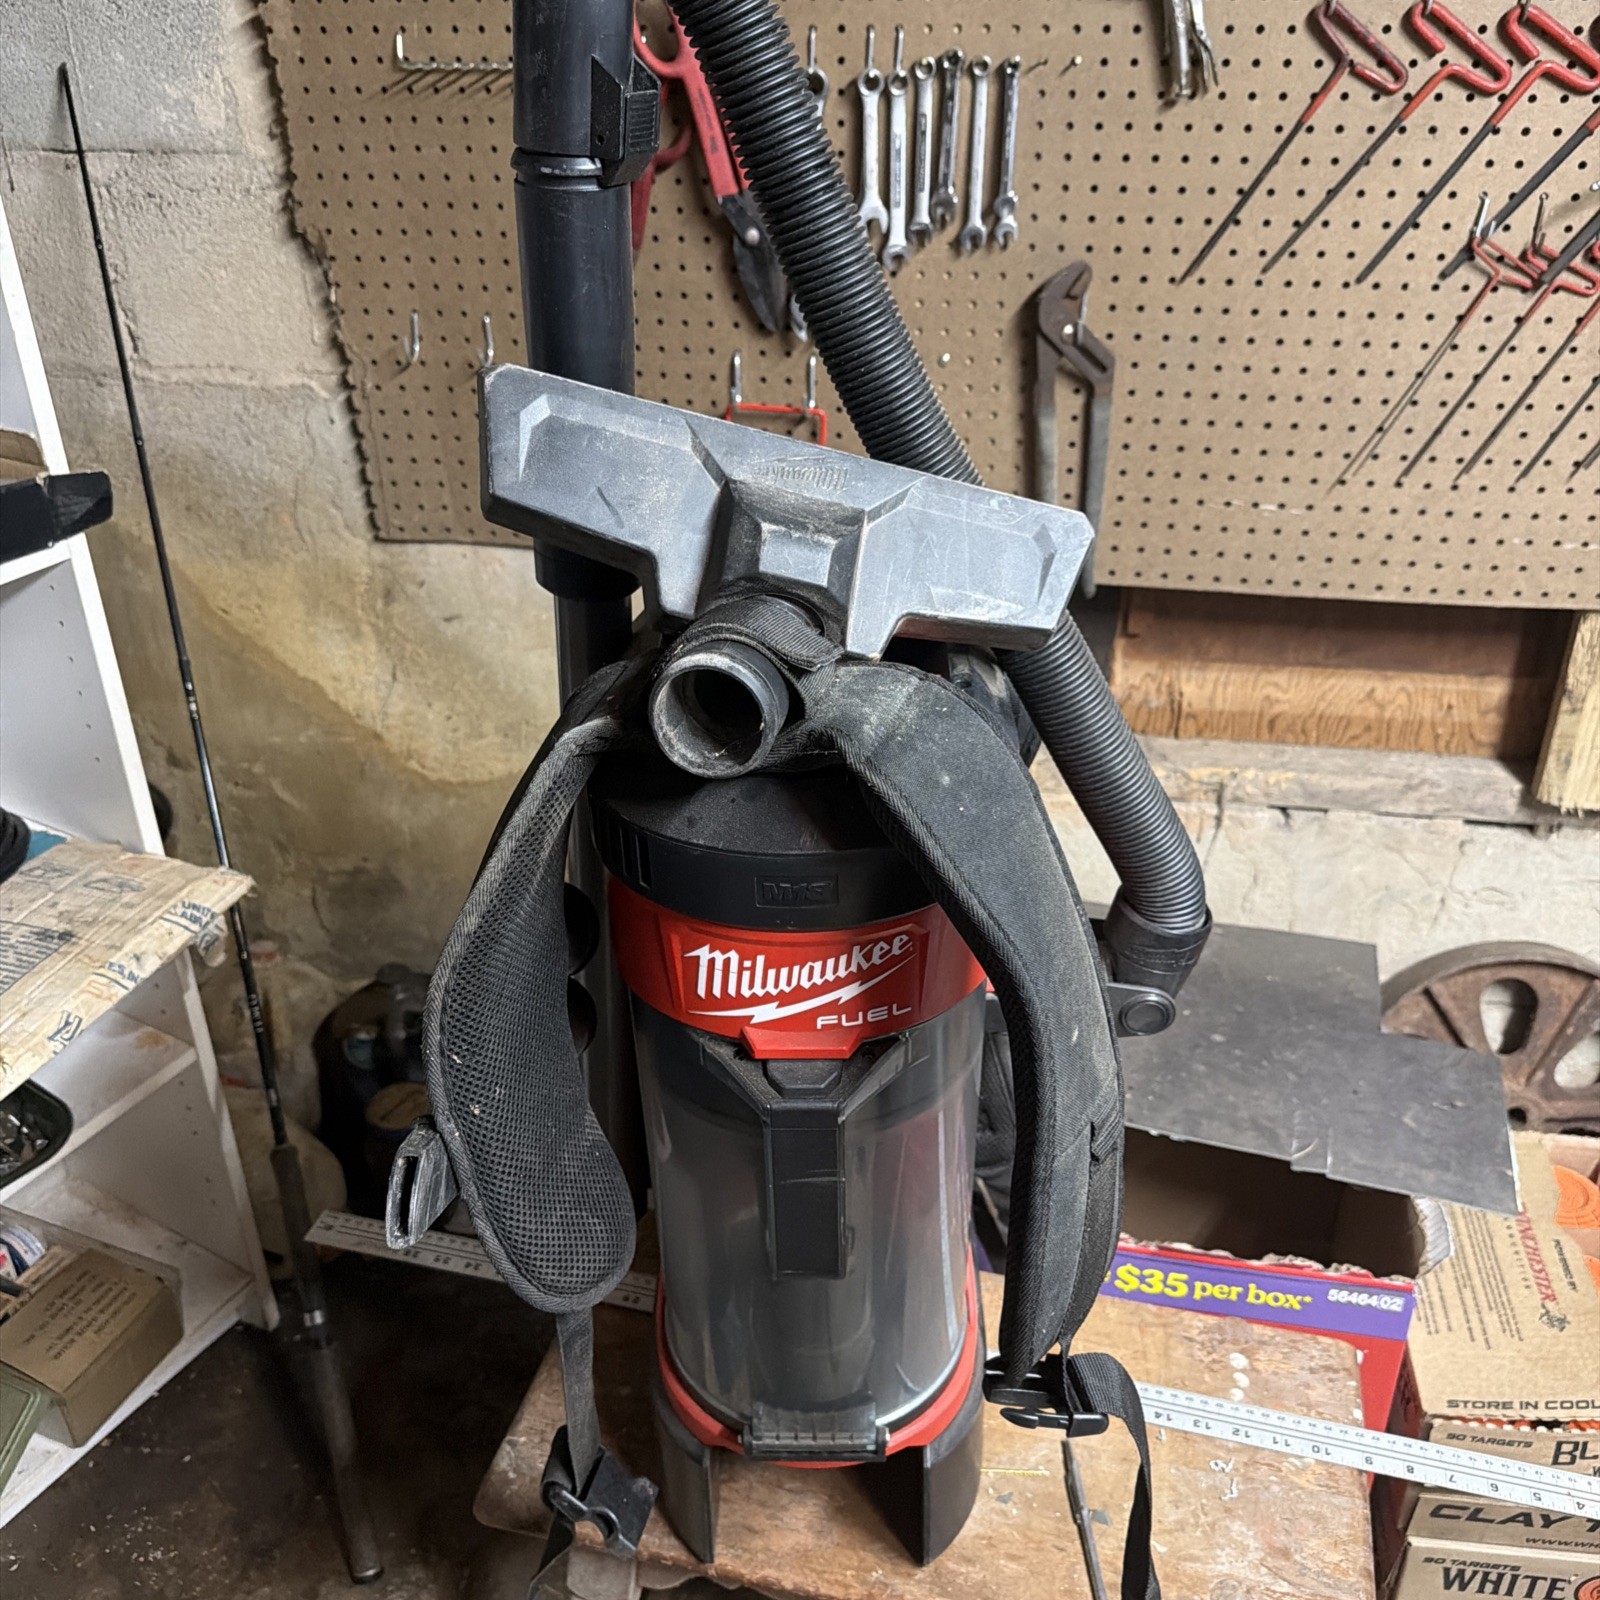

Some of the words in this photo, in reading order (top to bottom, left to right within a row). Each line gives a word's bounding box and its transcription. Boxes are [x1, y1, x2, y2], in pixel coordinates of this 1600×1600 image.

[684, 933, 914, 1000] Milwaukee
[816, 1003, 912, 1029] FUEL
[1114, 1263, 1189, 1298] $35
[1193, 1279, 1243, 1301] per
[1447, 1399, 1514, 1410] STORE
[1519, 1400, 1539, 1410] IN
[1545, 1399, 1600, 1410] COOL
[1154, 1411, 1172, 1423] 14
[1193, 1419, 1212, 1430] 13
[1232, 1428, 1251, 1439] 12
[1272, 1436, 1291, 1447] 11
[1469, 1435, 1534, 1448] TARGETS
[1312, 1445, 1332, 1457] 10
[1365, 1456, 1373, 1465] 9
[1406, 1465, 1415, 1474] 8
[1449, 1474, 1457, 1483] 7
[1490, 1483, 1499, 1492] 6
[1533, 1492, 1542, 1501] 5
[1576, 1501, 1585, 1510] 4
[1429, 1504, 1574, 1529] CLAY
[1450, 1559, 1522, 1572] TARGETS
[1442, 1566, 1572, 1600] WHITE
